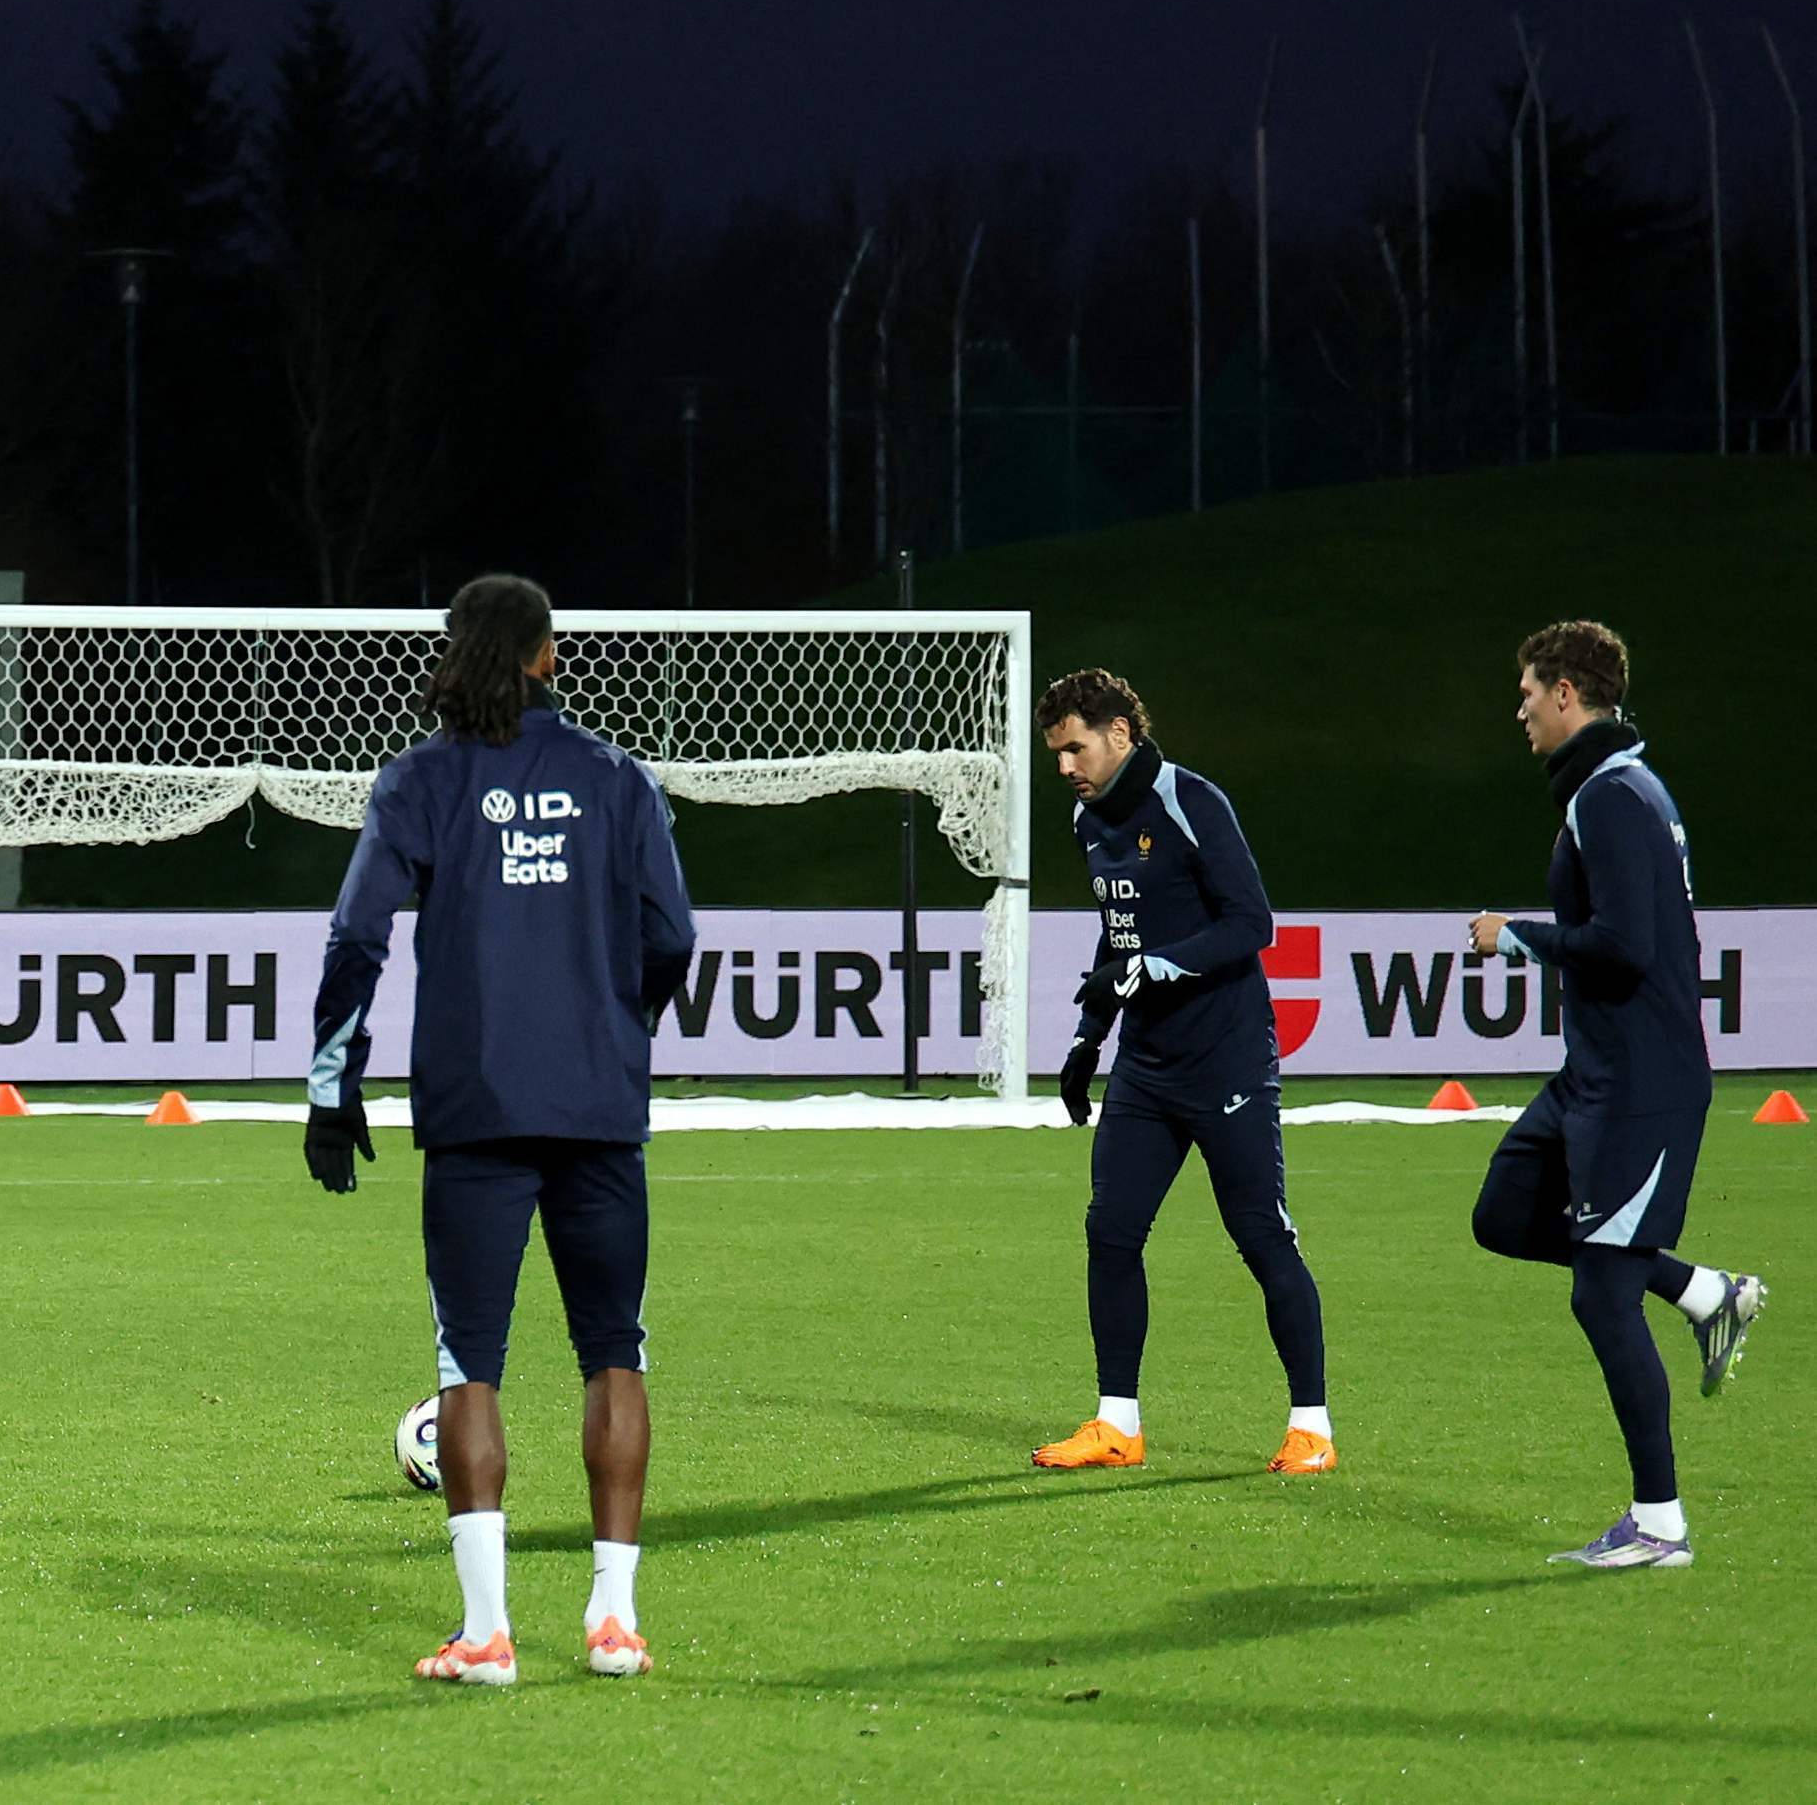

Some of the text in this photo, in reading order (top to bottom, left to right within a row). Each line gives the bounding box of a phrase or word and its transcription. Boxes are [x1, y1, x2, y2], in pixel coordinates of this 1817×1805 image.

[501, 829, 566, 857] Uber
[502, 856, 569, 885] Eats
[1105, 908, 1135, 928] Uber
[1109, 929, 1142, 949] Eats
[1350, 948, 1743, 1039] WÜH
